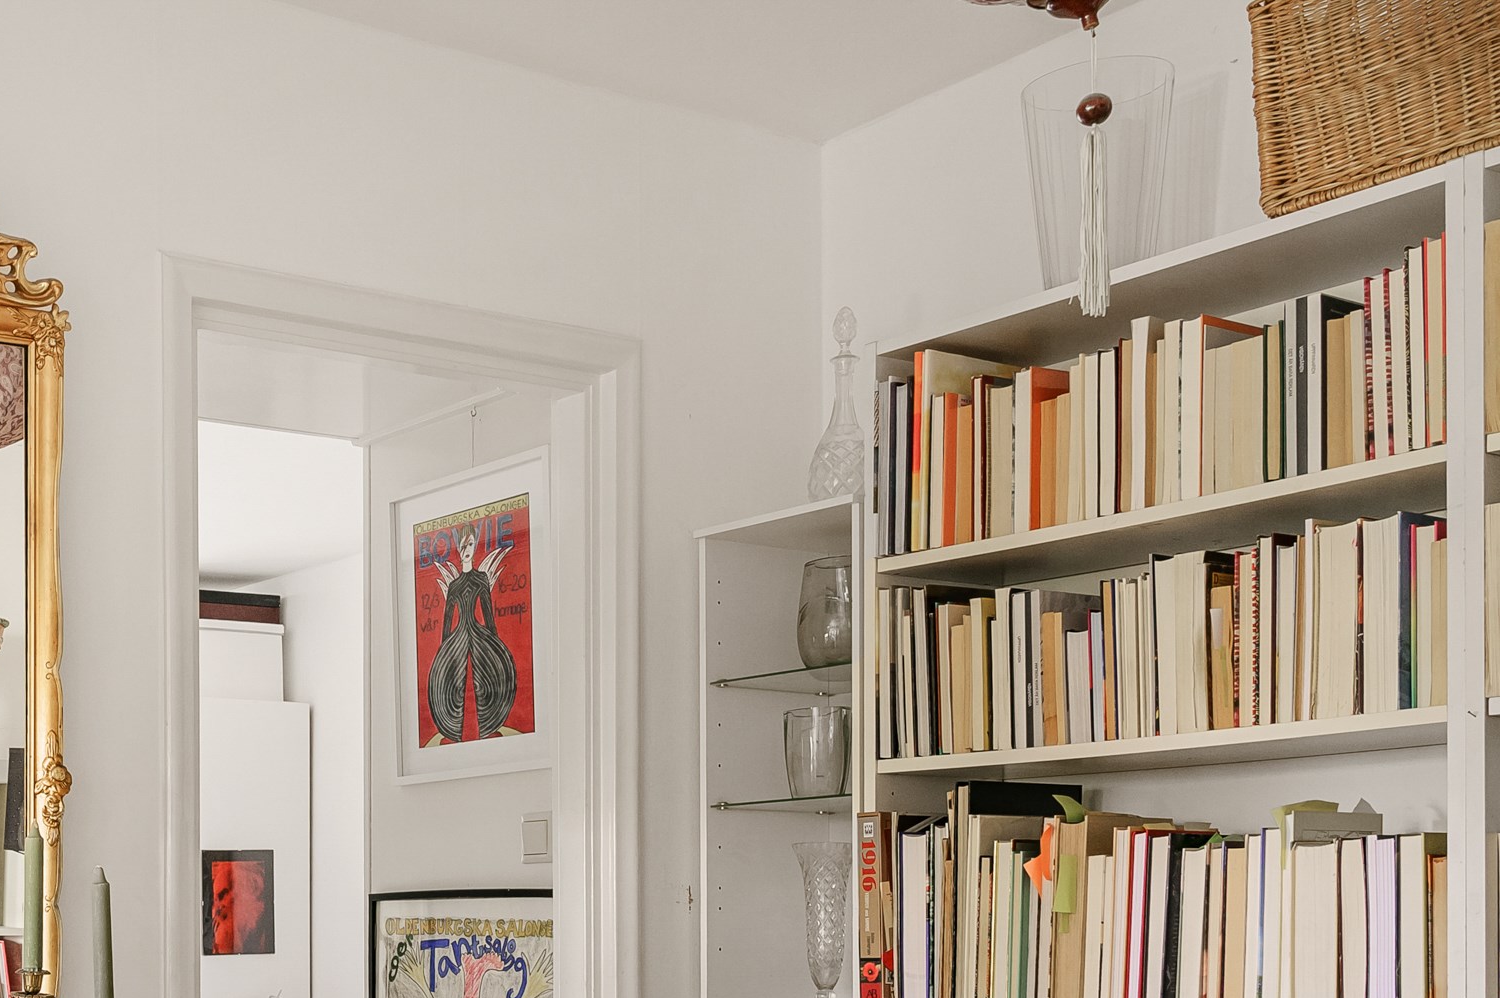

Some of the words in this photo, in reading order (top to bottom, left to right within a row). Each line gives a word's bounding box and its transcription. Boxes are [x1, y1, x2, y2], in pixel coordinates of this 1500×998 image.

[415, 510, 481, 534] OLDENBURGSKA
[483, 498, 528, 517] SALONGEN
[418, 514, 515, 568] BOWIE
[861, 839, 877, 892] 1916
[385, 916, 493, 936] OLDENBURGSKA
[495, 918, 554, 938] SALONGE
[866, 988, 878, 998] AB
